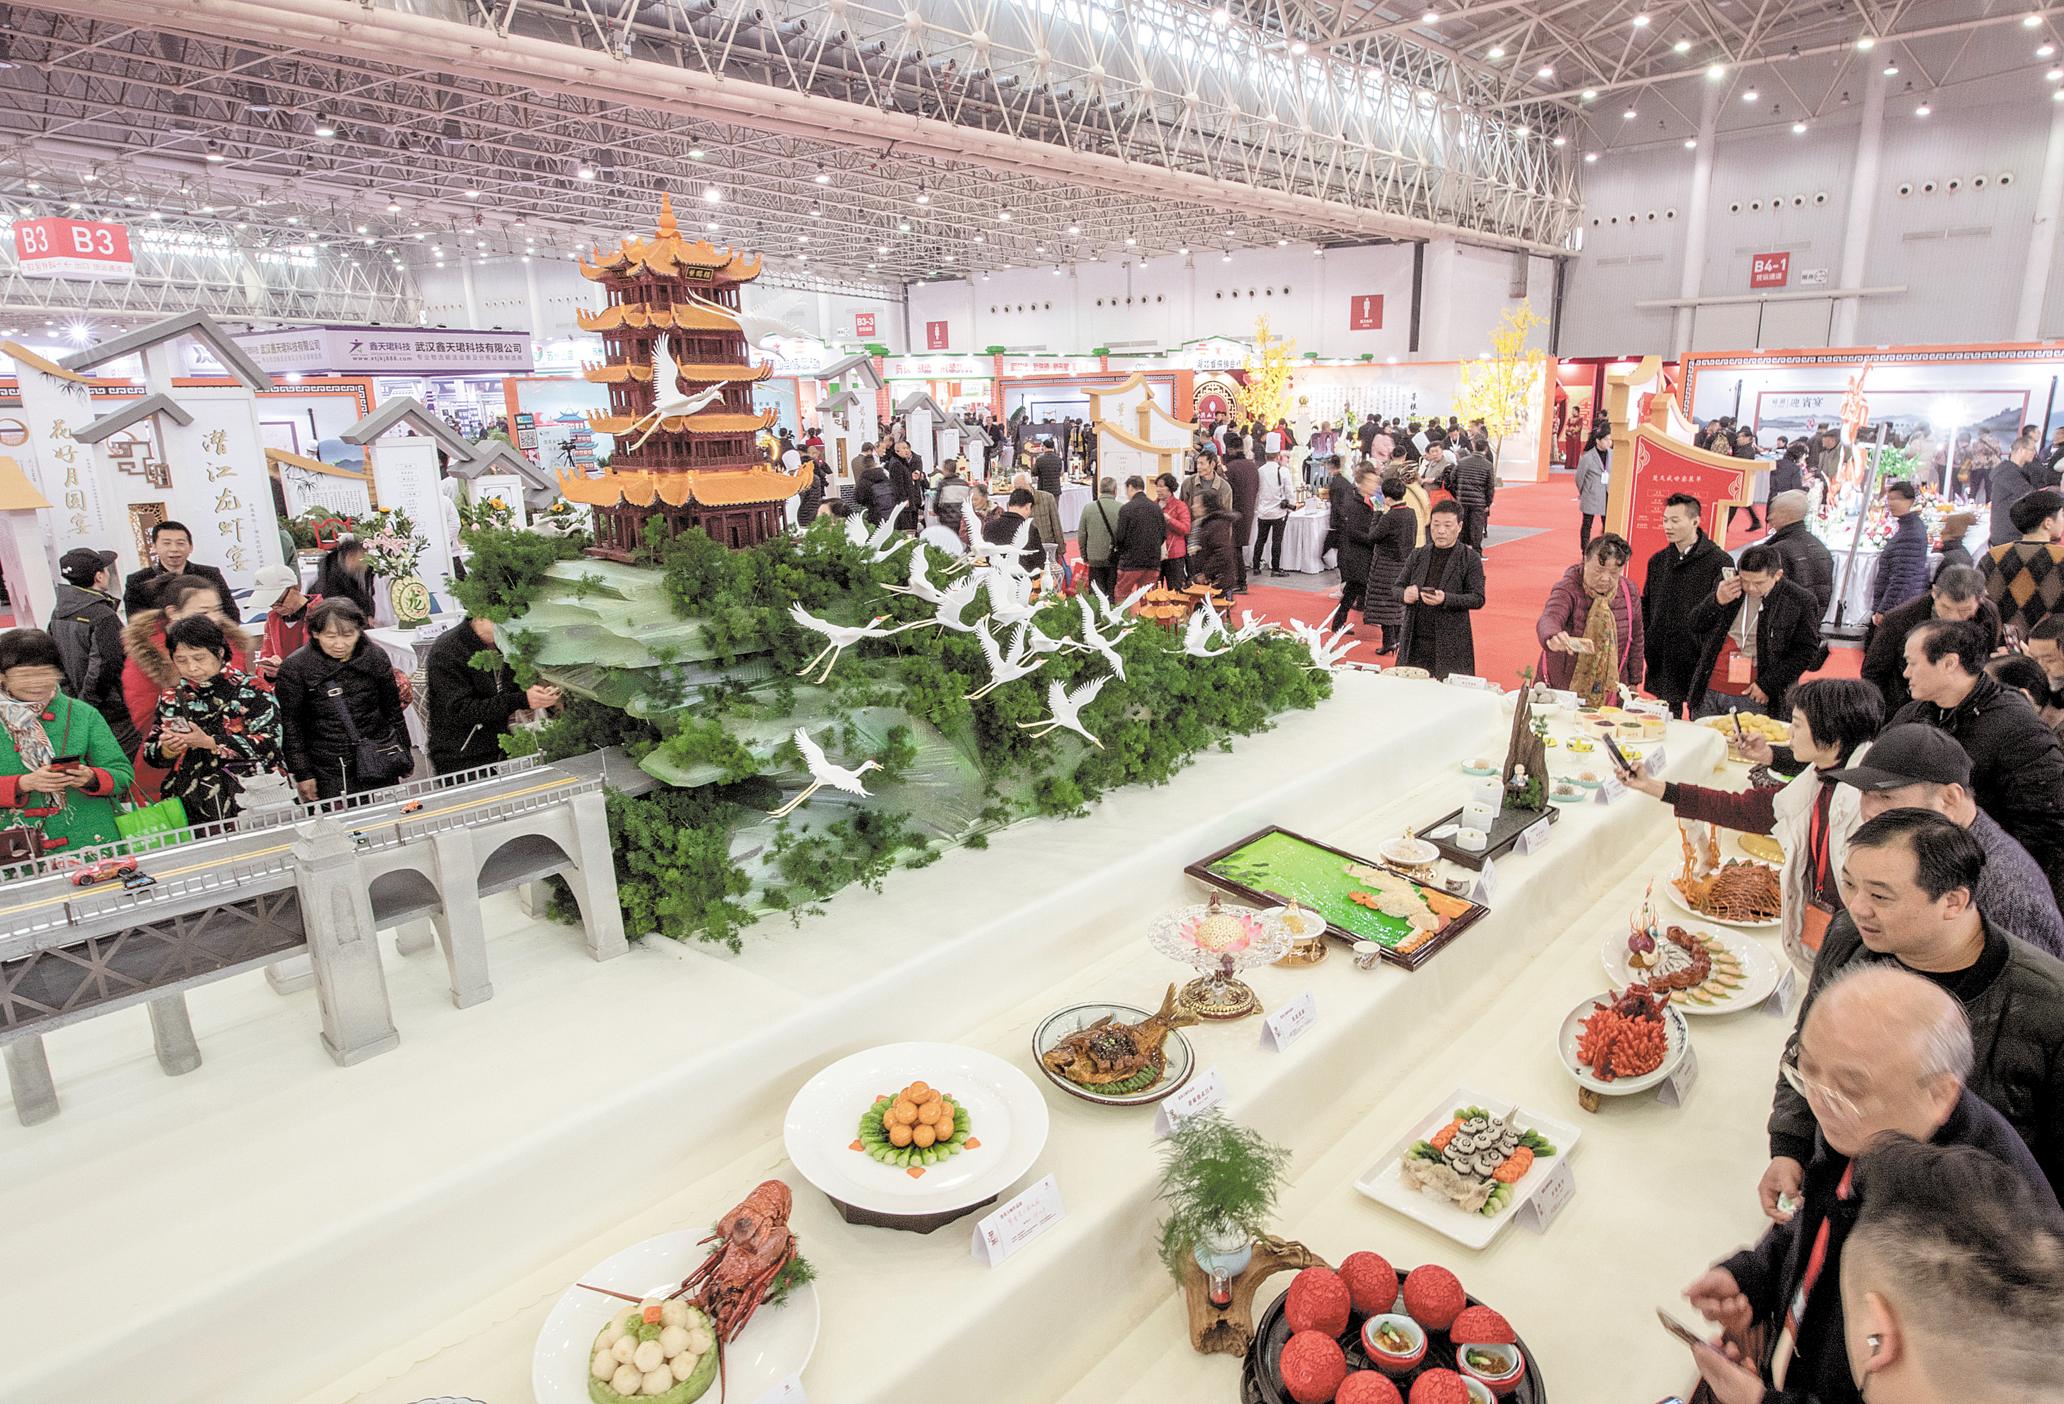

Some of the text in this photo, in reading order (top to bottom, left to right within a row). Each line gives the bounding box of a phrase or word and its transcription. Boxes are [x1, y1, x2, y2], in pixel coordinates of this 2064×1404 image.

[22, 226, 49, 253] B3
[71, 226, 115, 255] B3
[1754, 257, 1787, 273] B4-1
[857, 317, 874, 326] B3-3
[414, 341, 522, 354] 武汉鑫天珺科技有限公司
[50, 419, 92, 535] 花好月圆宴
[202, 429, 249, 572] 潜江龙虾宴
